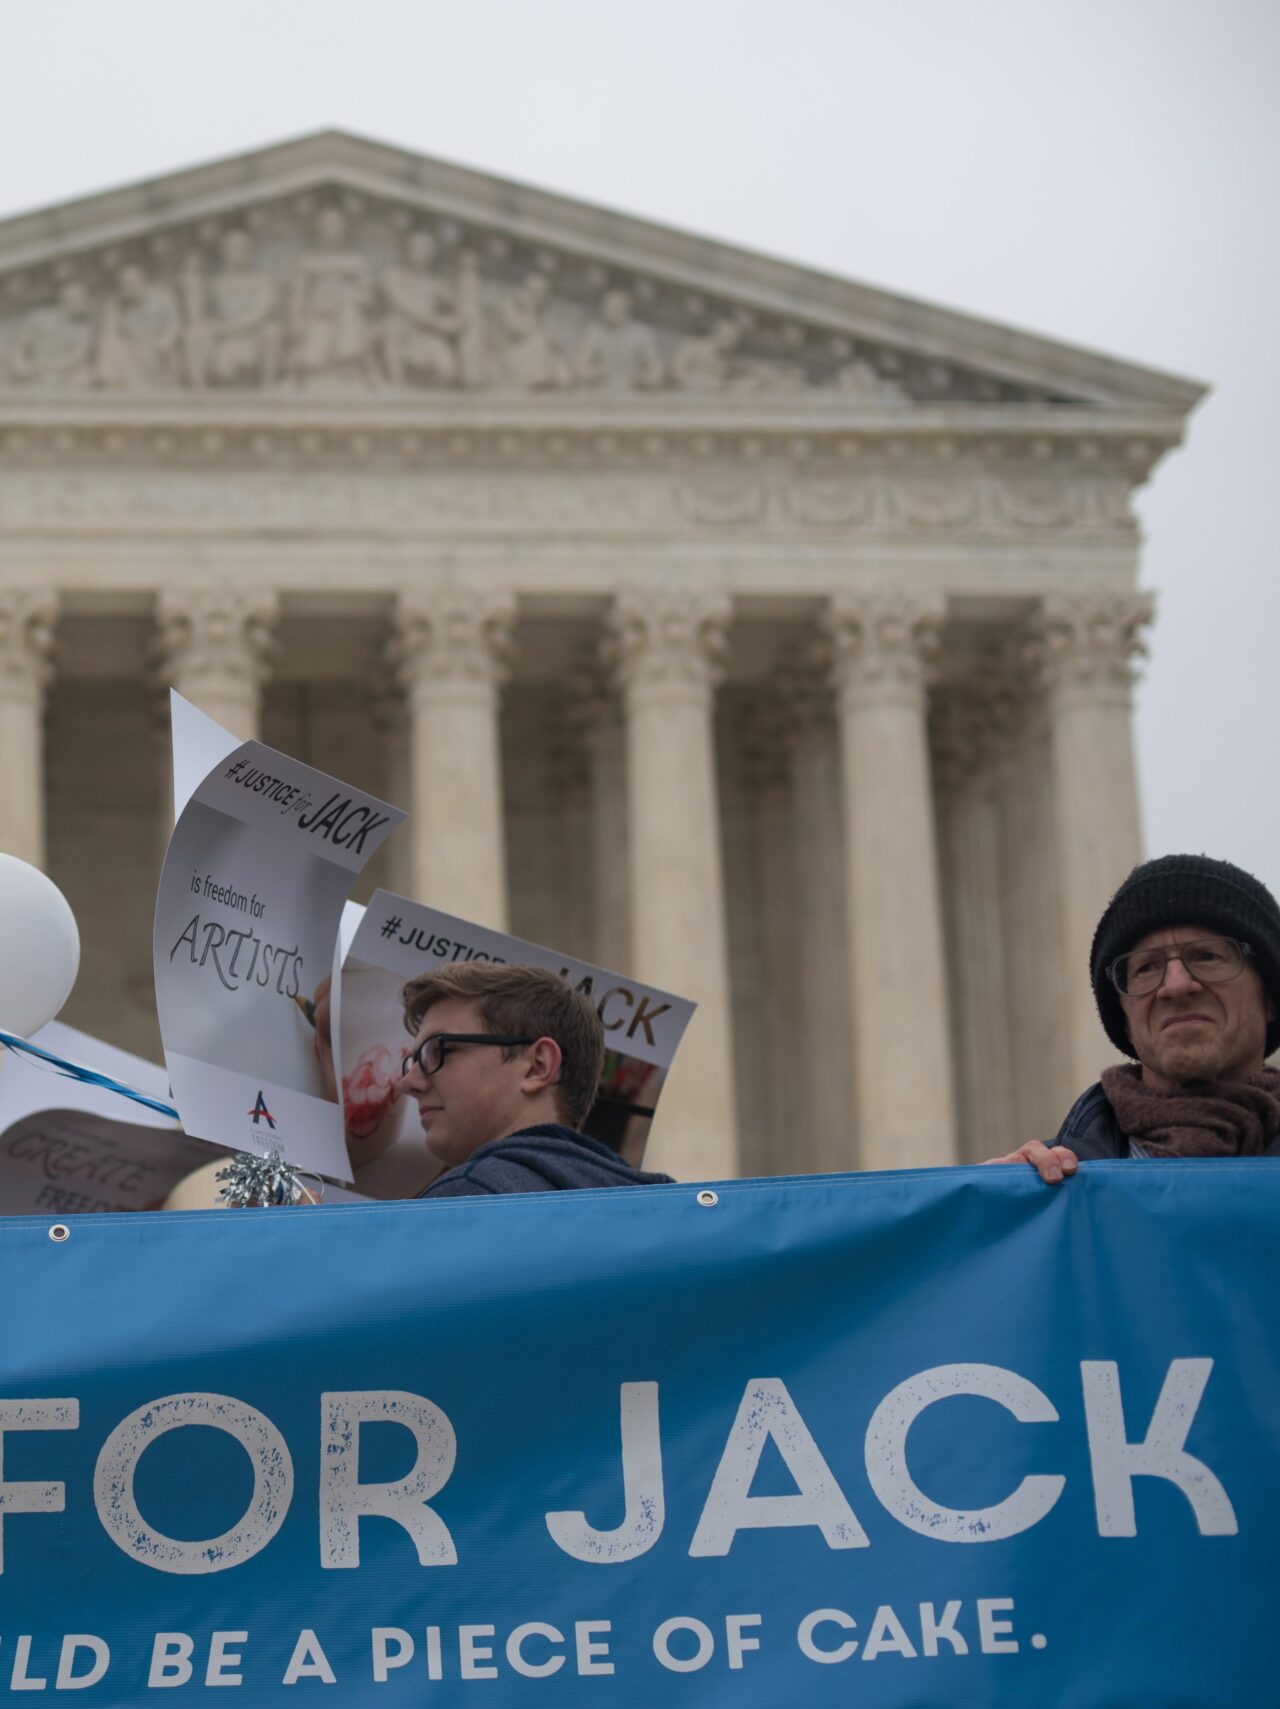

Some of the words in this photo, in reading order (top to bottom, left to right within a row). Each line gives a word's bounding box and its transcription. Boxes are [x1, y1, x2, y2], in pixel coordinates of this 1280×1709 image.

[224, 759, 301, 806] #JUSTICE
[280, 792, 312, 815] for
[298, 793, 389, 854] JACK
[190, 868, 202, 894] is
[204, 875, 247, 913] freedom
[250, 894, 266, 919] for
[170, 914, 304, 998] ARTISTS
[546, 1357, 1238, 1564] JACK
[147, 1630, 249, 1689] BE
[282, 1629, 337, 1685] A
[371, 1620, 615, 1682] PIECE
[652, 1613, 763, 1673] OF
[797, 1597, 1048, 1665] CAKE.
